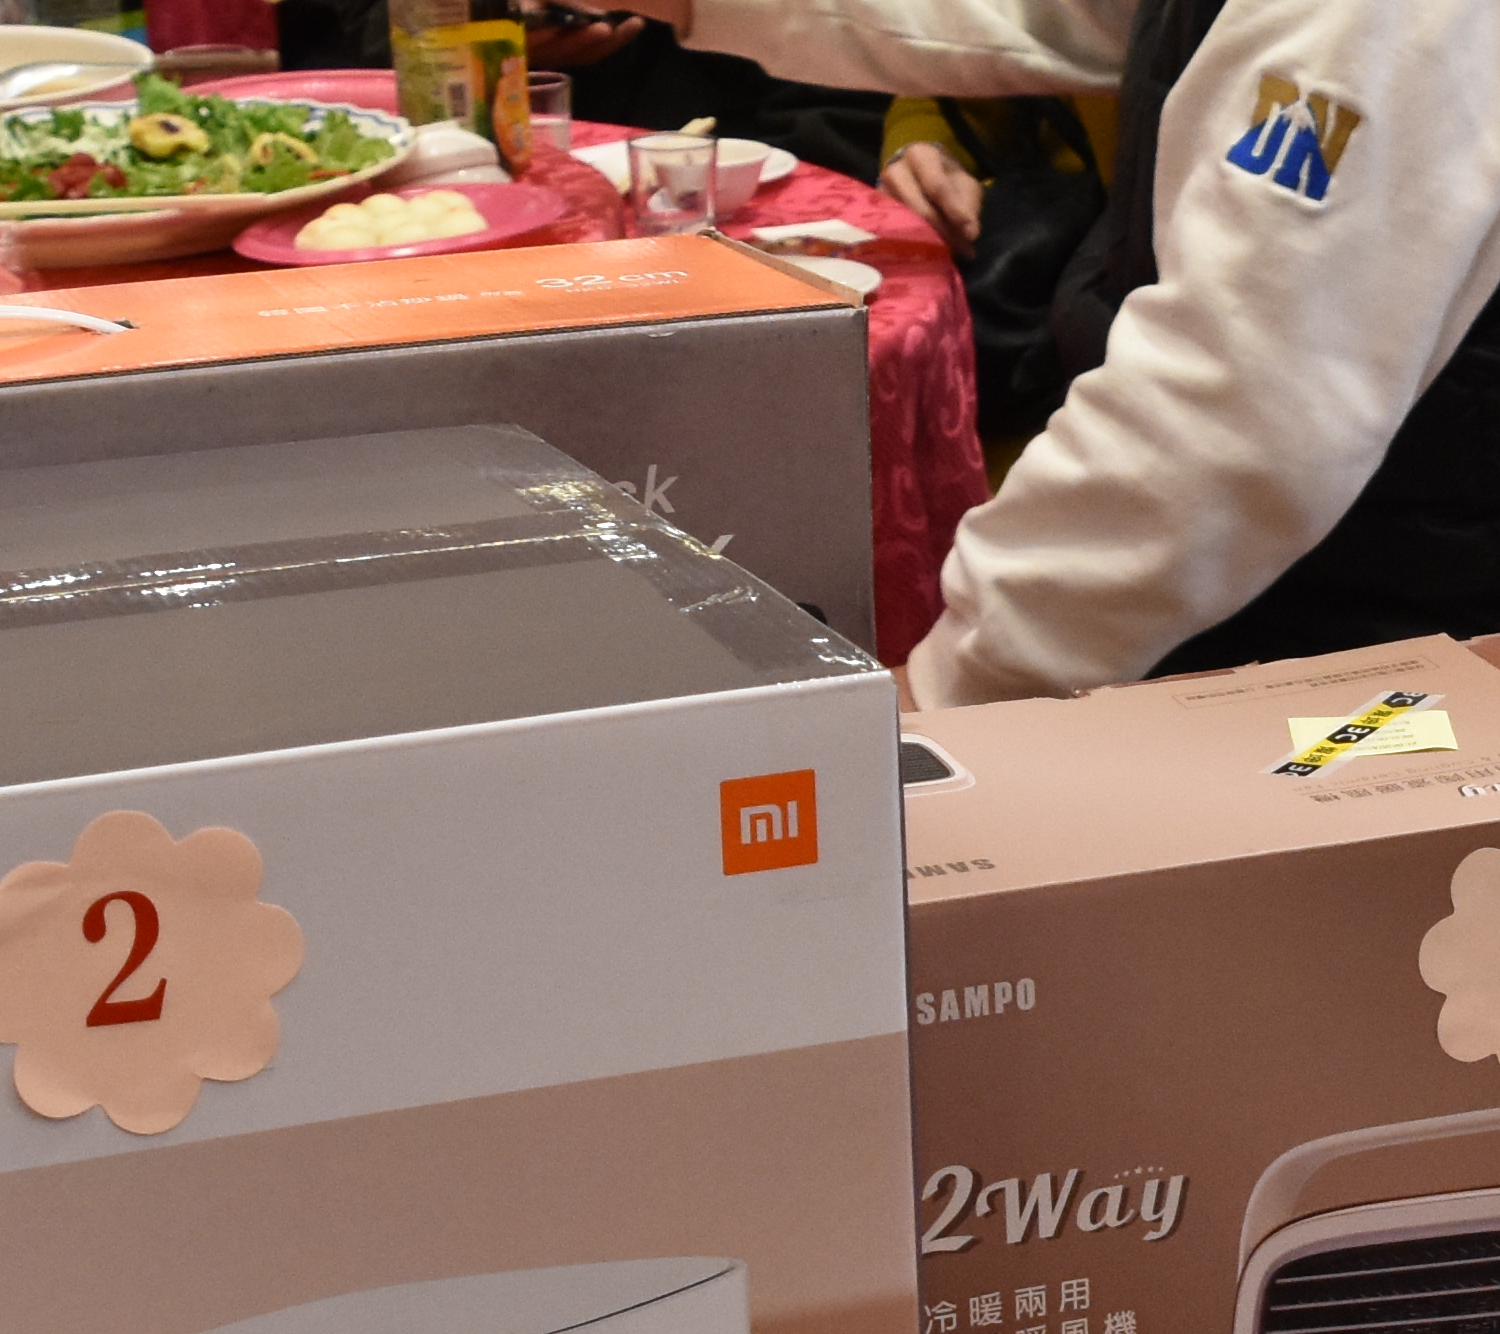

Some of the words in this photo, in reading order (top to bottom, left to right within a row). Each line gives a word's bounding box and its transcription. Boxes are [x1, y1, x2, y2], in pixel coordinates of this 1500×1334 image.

[535, 274, 612, 288] 32
[618, 270, 688, 283] cm
[82, 890, 167, 1028] 2
[916, 977, 1037, 1027] SAMPO
[921, 1164, 1189, 1255] 2Way
[924, 1278, 1090, 1334] 冷暖兩用
